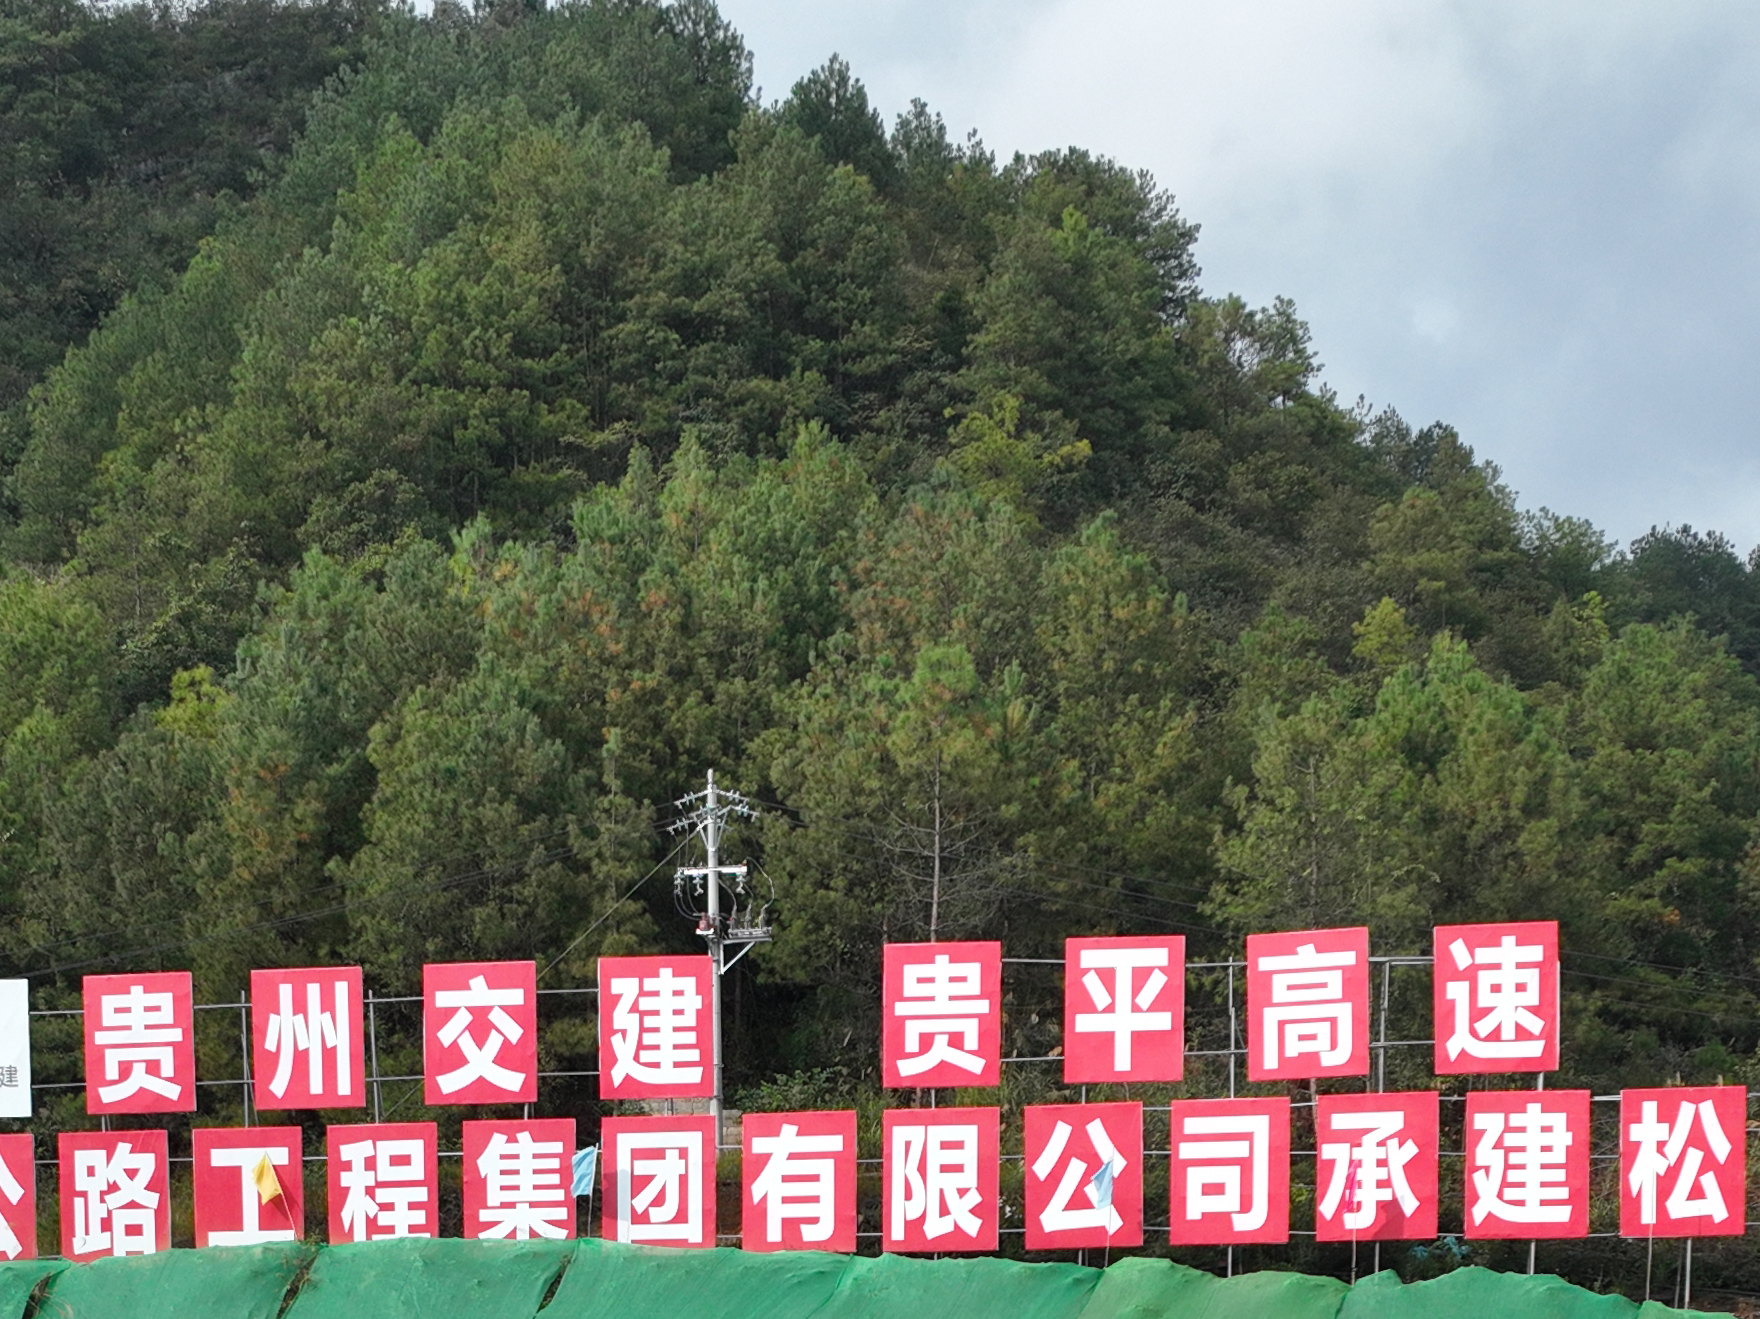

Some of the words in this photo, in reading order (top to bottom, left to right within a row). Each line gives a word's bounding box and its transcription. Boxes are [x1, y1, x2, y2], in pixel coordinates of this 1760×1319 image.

[93, 973, 705, 1103] 贵州交建
[895, 935, 1547, 1076] 贵平高速
